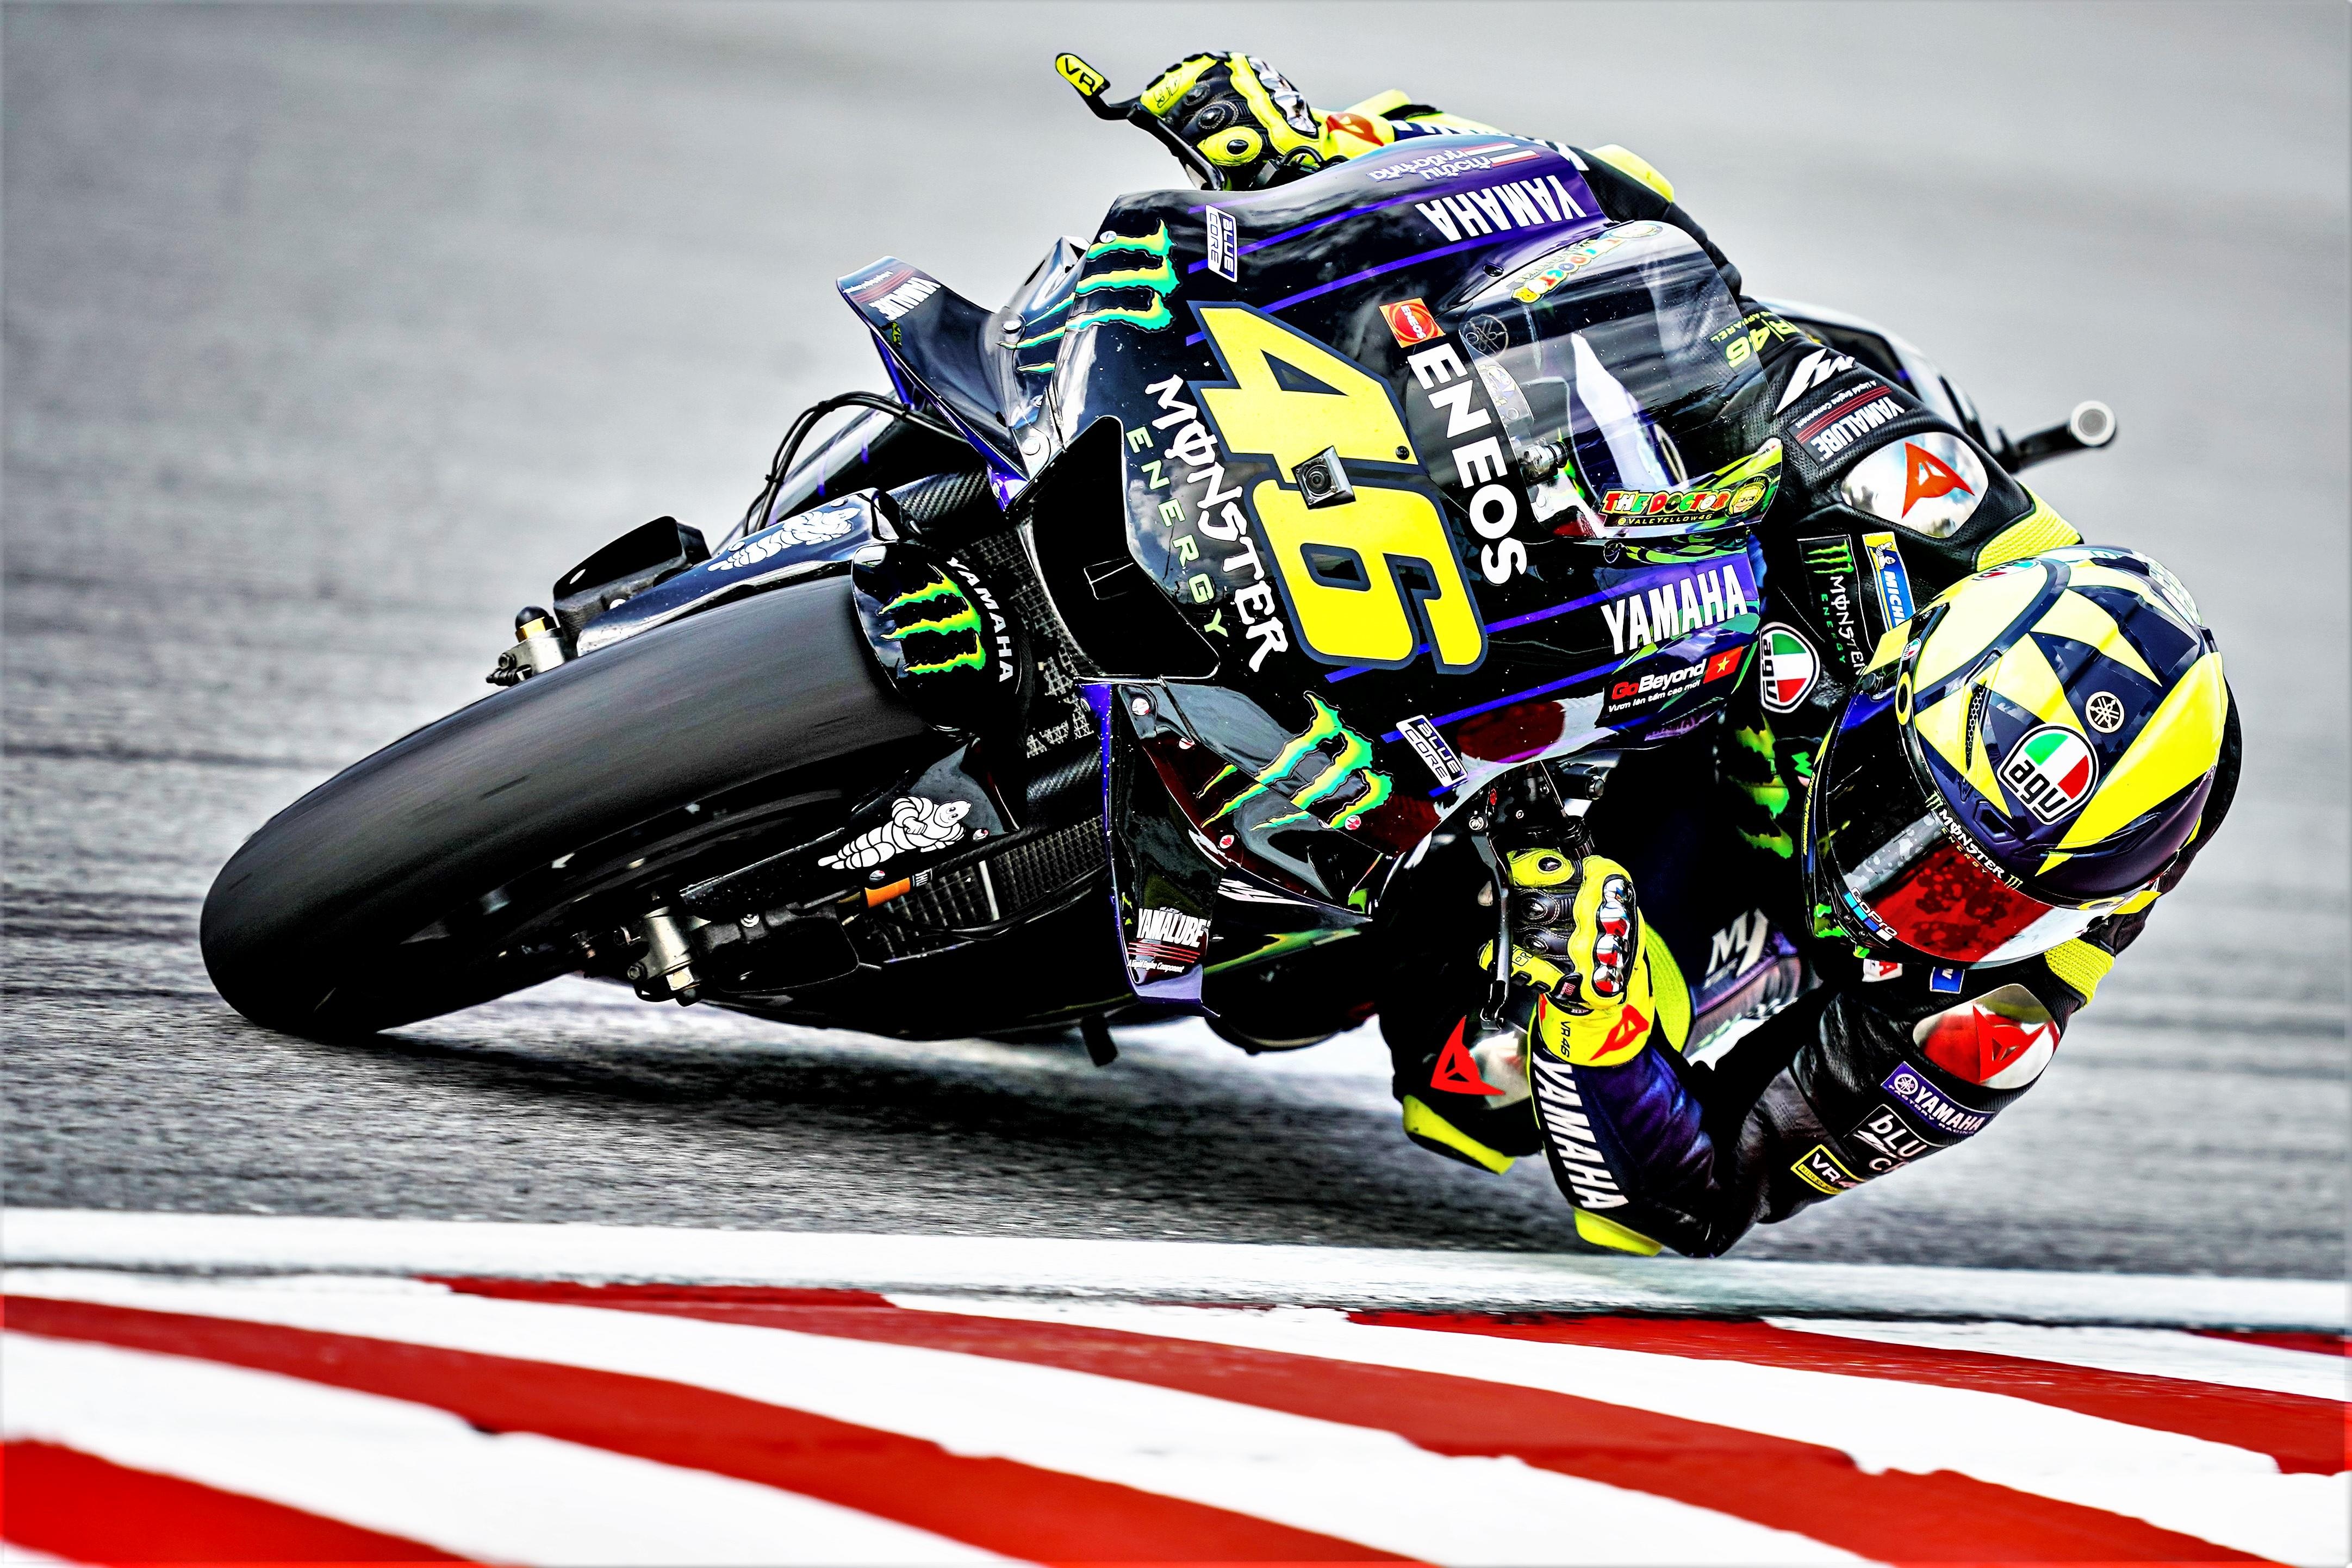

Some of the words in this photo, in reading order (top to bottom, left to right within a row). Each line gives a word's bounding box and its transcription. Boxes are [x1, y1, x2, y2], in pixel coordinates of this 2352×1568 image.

[1063, 57, 1097, 95] VR
[1415, 175, 1588, 242] YAMAHA
[1209, 211, 1219, 265] CORE
[1222, 214, 1235, 273] BLUE
[1401, 304, 1426, 340] ENEOS
[1795, 402, 1832, 429] Component
[1831, 389, 1853, 405] Engine
[1852, 383, 1871, 395] Liquid
[1810, 396, 1905, 460] YAMALUBE
[1196, 304, 1484, 669] 46
[1408, 343, 1528, 586] ENEOS
[1145, 374, 1289, 673] MONSTER
[1604, 491, 1650, 514] THE
[1647, 490, 1733, 514] DOCTOR
[1617, 512, 1713, 526] @VALEYELLOW46
[1126, 426, 1228, 638] ENERGY
[946, 557, 1014, 683] YAMAHA
[1601, 563, 1749, 655] YAMAHA
[1884, 571, 1906, 626] MICH
[1821, 594, 1846, 664] ENERGY
[1667, 686, 1683, 697] cao
[1762, 638, 1779, 704] agv
[1404, 729, 1448, 779] CORE
[1417, 722, 1461, 774] BLUE
[2006, 761, 2070, 818] agv
[1939, 809, 2005, 881] MONSTER
[1941, 826, 1990, 876] ENERGY
[1136, 908, 1205, 948] YAMALUBE
[1848, 886, 1898, 937] GoPro
[1532, 1049, 1629, 1209] YAMAHA
[1888, 1085, 1934, 1120] FACTORY
[1914, 1085, 1986, 1131] YAMAHA
